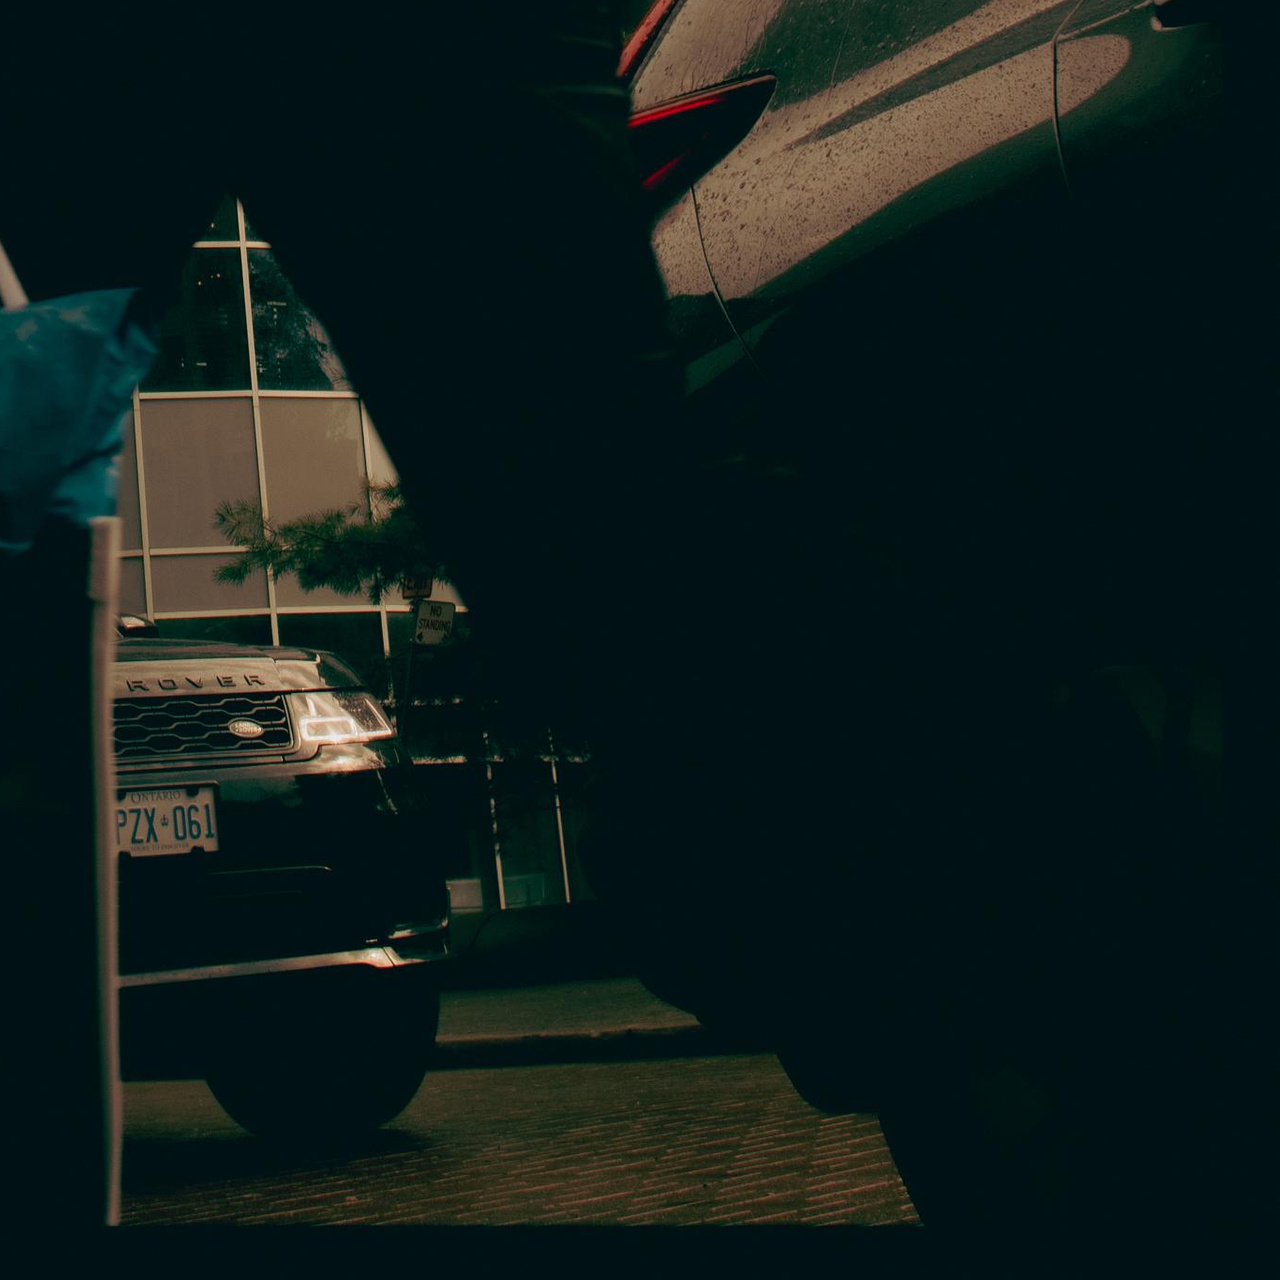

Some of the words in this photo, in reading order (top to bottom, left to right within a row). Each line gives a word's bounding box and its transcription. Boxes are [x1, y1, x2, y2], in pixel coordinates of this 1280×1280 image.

[430, 605, 442, 617] NO
[417, 618, 451, 631] STANDING
[126, 674, 265, 692] ROVER
[131, 791, 181, 804] ONTARIO
